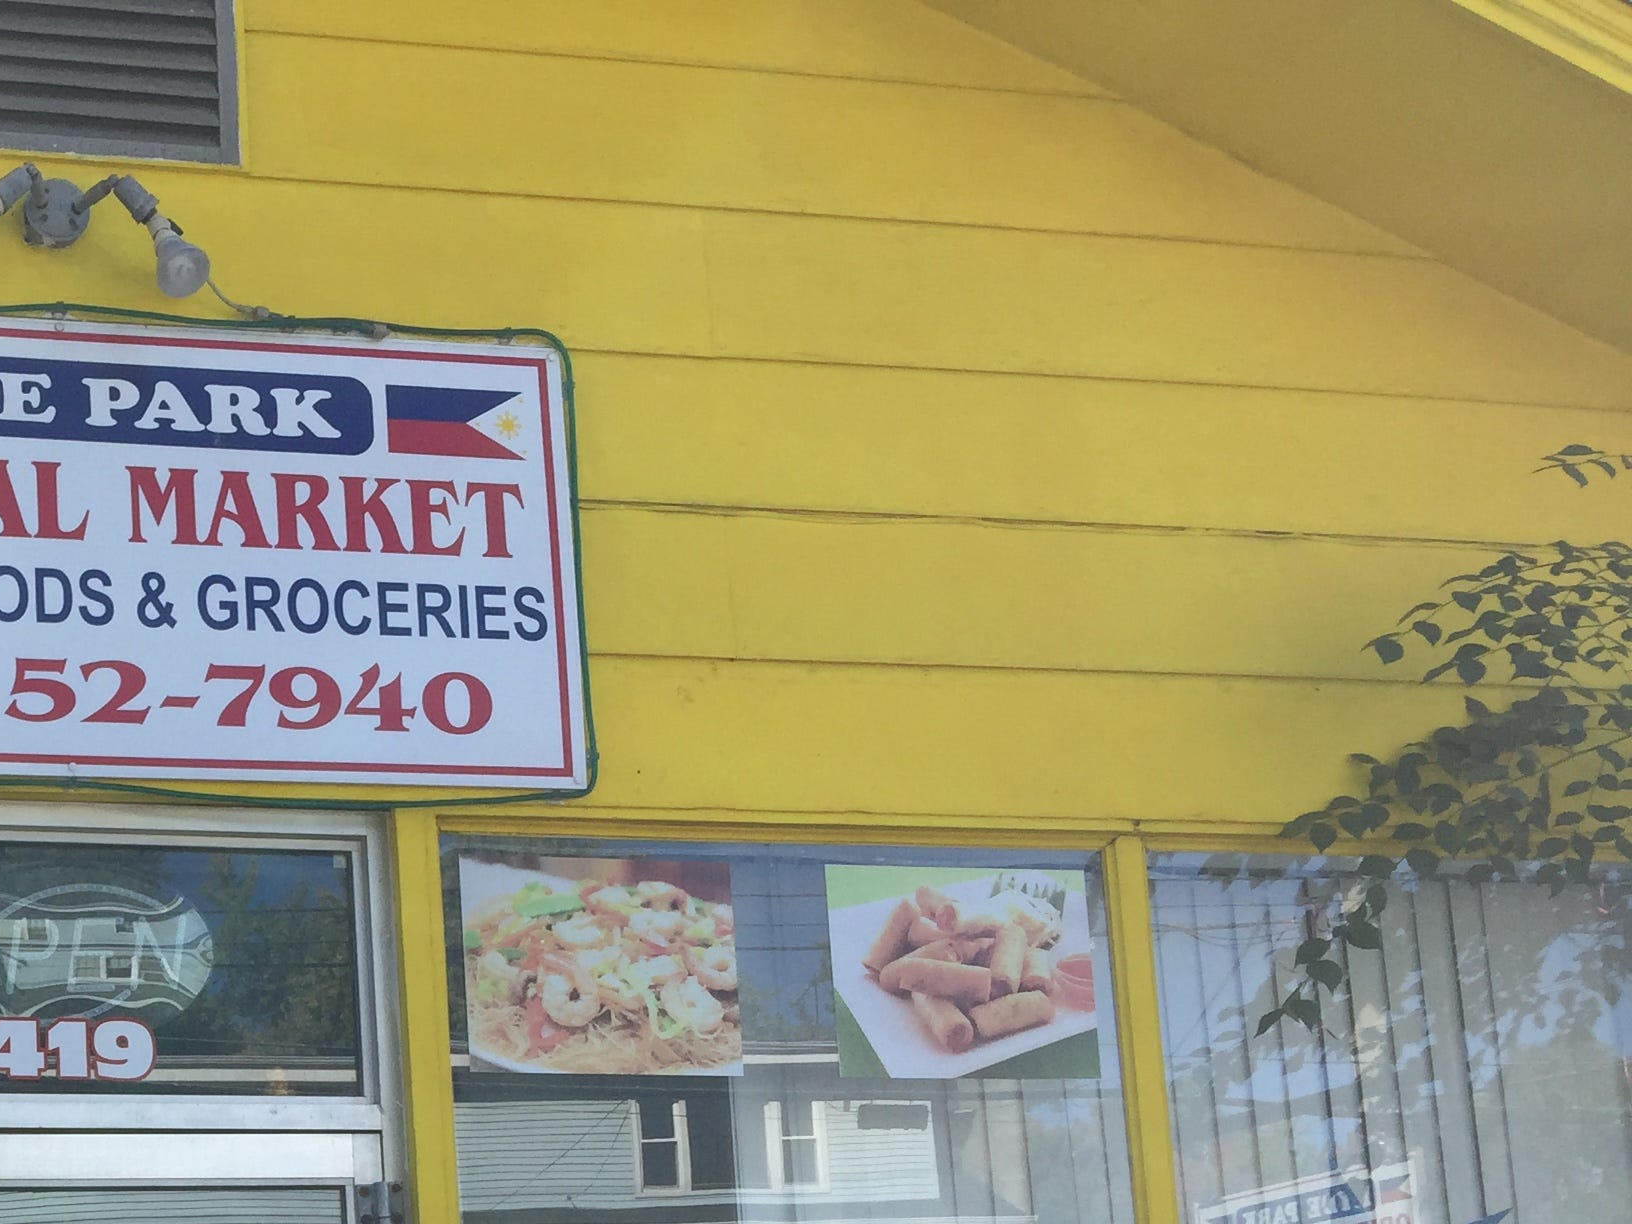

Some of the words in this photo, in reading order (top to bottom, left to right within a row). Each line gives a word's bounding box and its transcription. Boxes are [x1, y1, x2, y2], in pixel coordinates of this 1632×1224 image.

[84, 377, 341, 440] PARK
[125, 464, 524, 561] MARKET
[137, 570, 179, 631] &
[196, 573, 548, 643] GROCERIES
